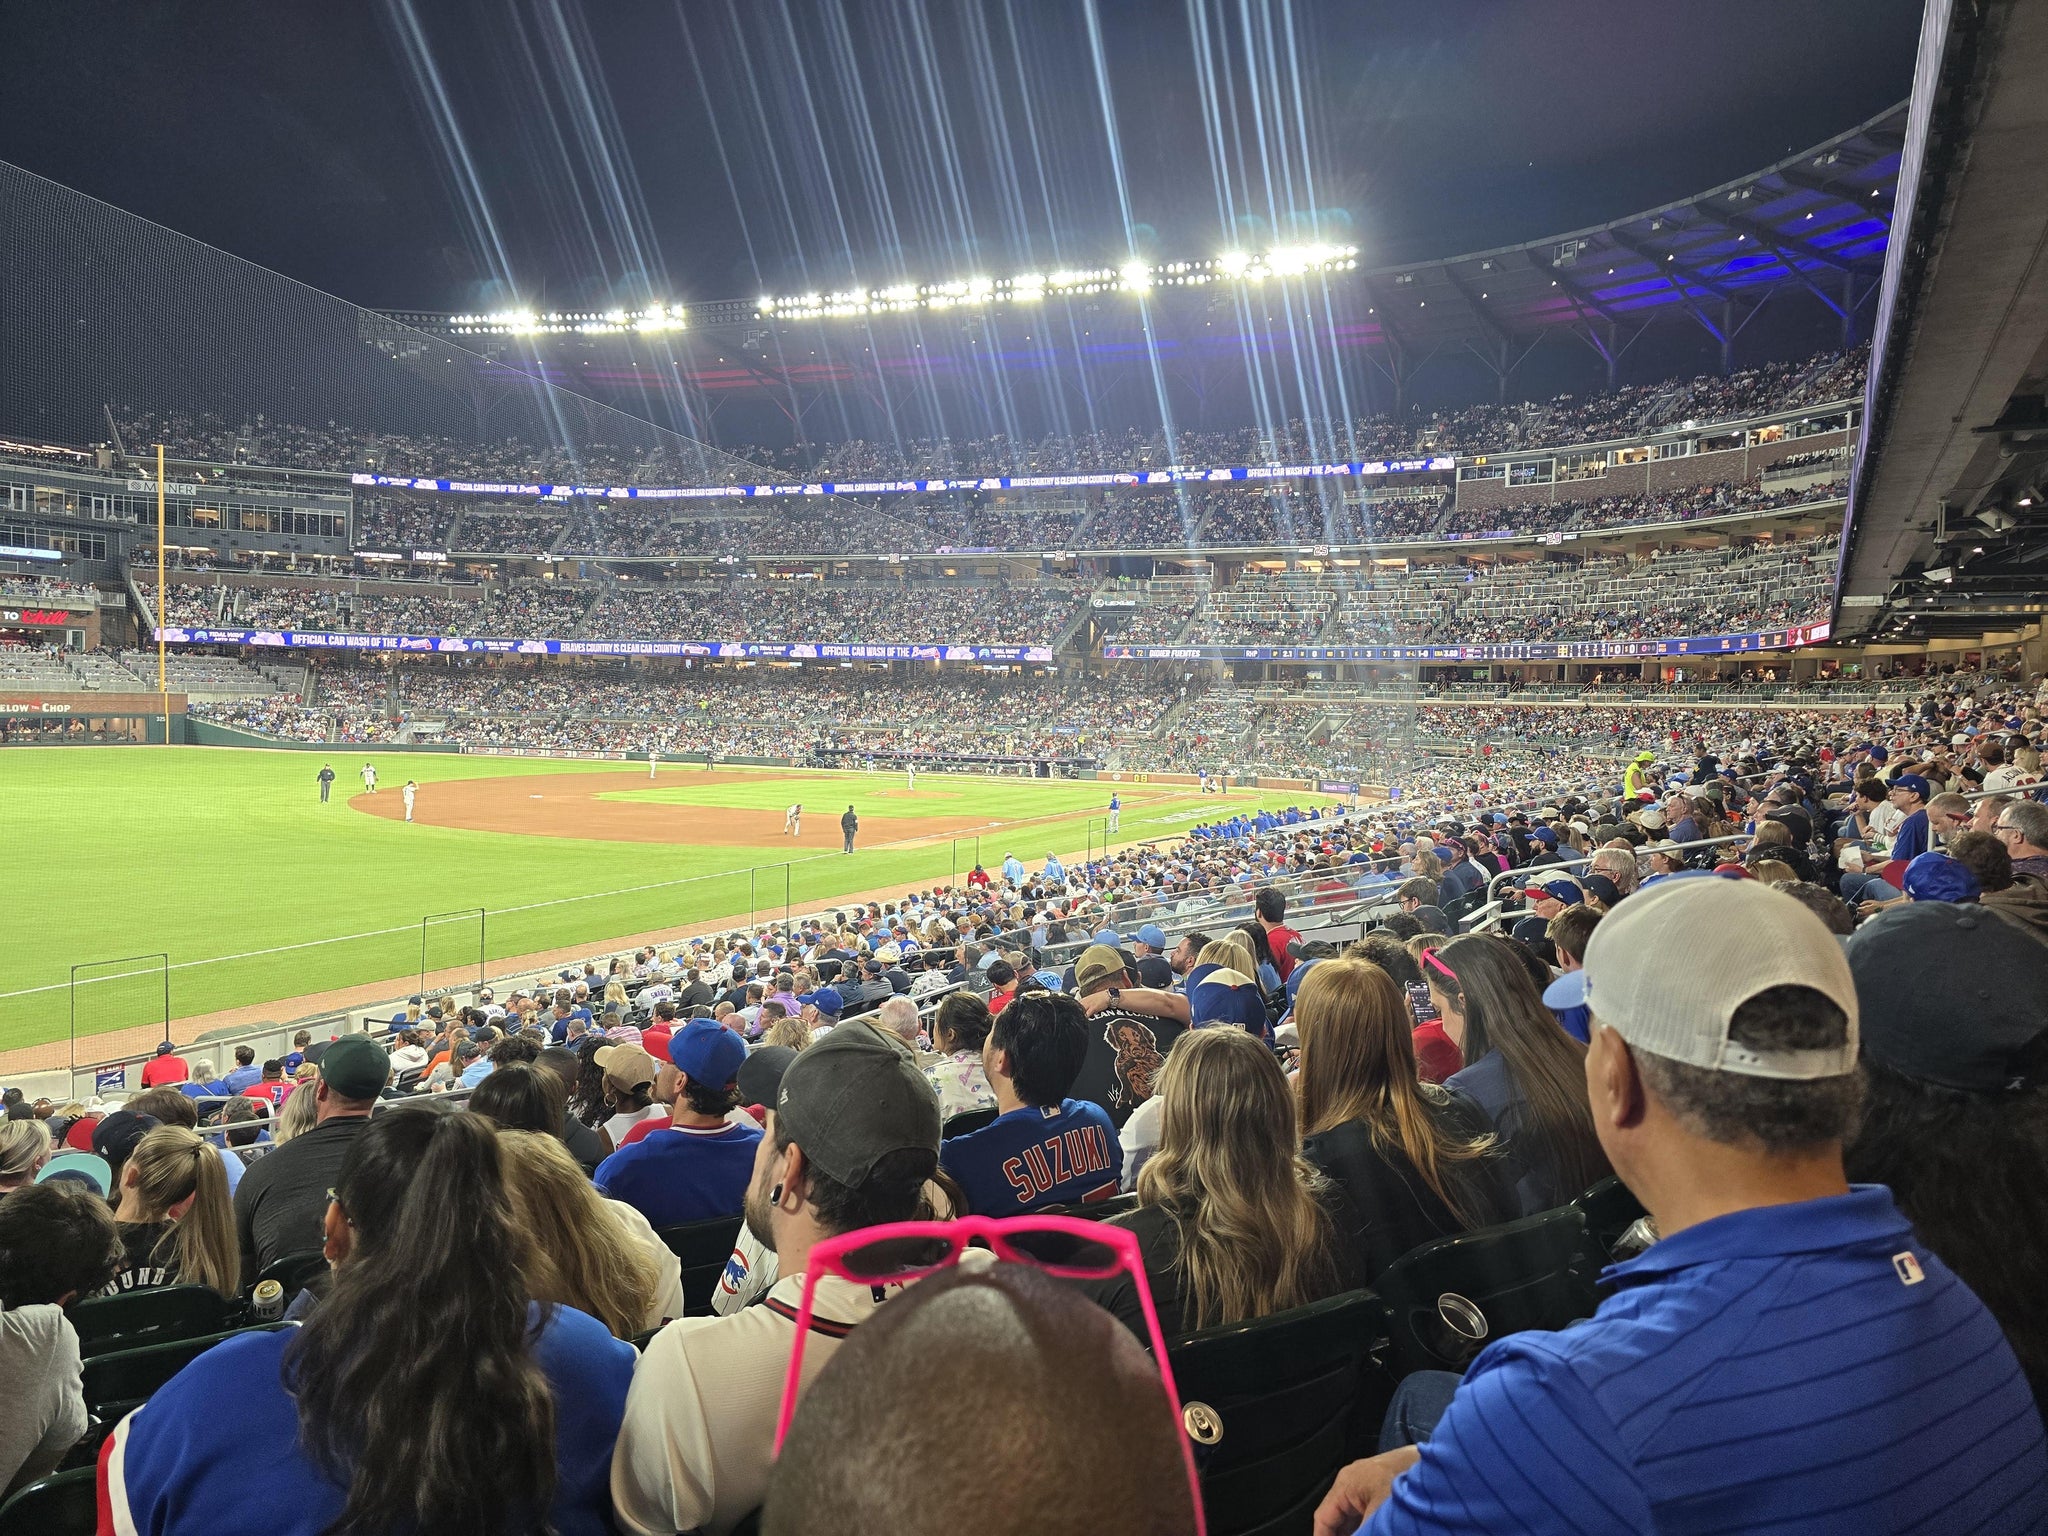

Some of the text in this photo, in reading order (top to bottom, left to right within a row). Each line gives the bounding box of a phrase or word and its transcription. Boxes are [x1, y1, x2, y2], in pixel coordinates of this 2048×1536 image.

[1248, 468, 1272, 477] OFFICIAL
[1273, 467, 1285, 476] CAR
[1286, 466, 1302, 475] WASH
[1303, 466, 1312, 475] OF
[1312, 465, 1324, 474] THE
[1031, 477, 1054, 486] COUNTRY
[1089, 475, 1113, 484] COUNTRY
[1546, 532, 1562, 545] 29
[1313, 544, 1329, 556] 25
[3, 611, 19, 620] TO
[292, 634, 328, 645] OFFICIAL
[328, 635, 346, 646] CAR
[346, 636, 370, 647] WASH
[370, 637, 381, 647] OF
[381, 637, 398, 648] THE
[560, 643, 682, 654] BRAVES COUNTRY IS CLEAN CAR COUNTRY
[822, 646, 851, 656] OFFICIAL
[851, 646, 866, 656] CAR
[866, 646, 886, 657] WASH
[886, 647, 896, 657] OF
[897, 647, 910, 657] THE
[1171, 650, 1201, 658] FUENTES
[1246, 650, 1258, 658] RHP
[0, 704, 29, 712] ELOW
[271, 1086, 284, 1104] 7
[1002, 1125, 1111, 1204] SUZUKI
